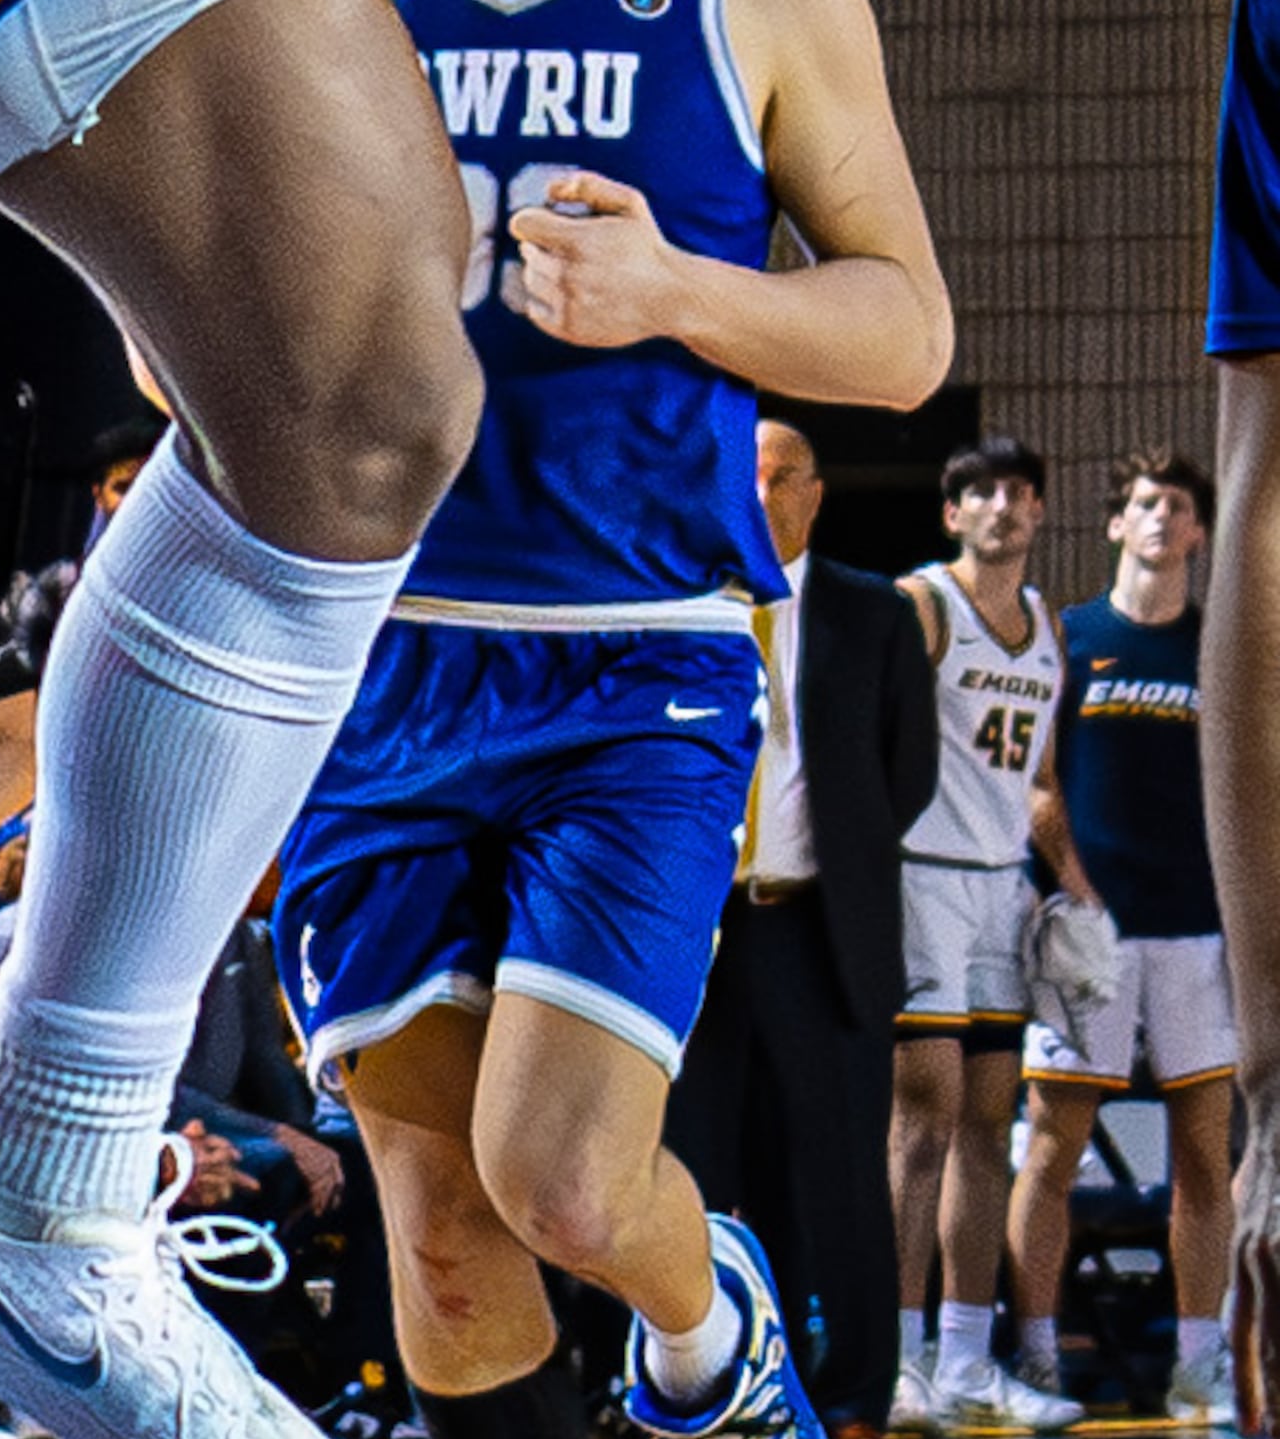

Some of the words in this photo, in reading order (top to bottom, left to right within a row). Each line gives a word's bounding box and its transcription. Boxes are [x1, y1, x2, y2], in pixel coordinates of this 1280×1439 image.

[418, 48, 641, 139] WRU
[958, 668, 1053, 702] EMORY
[974, 705, 1037, 772] 45
